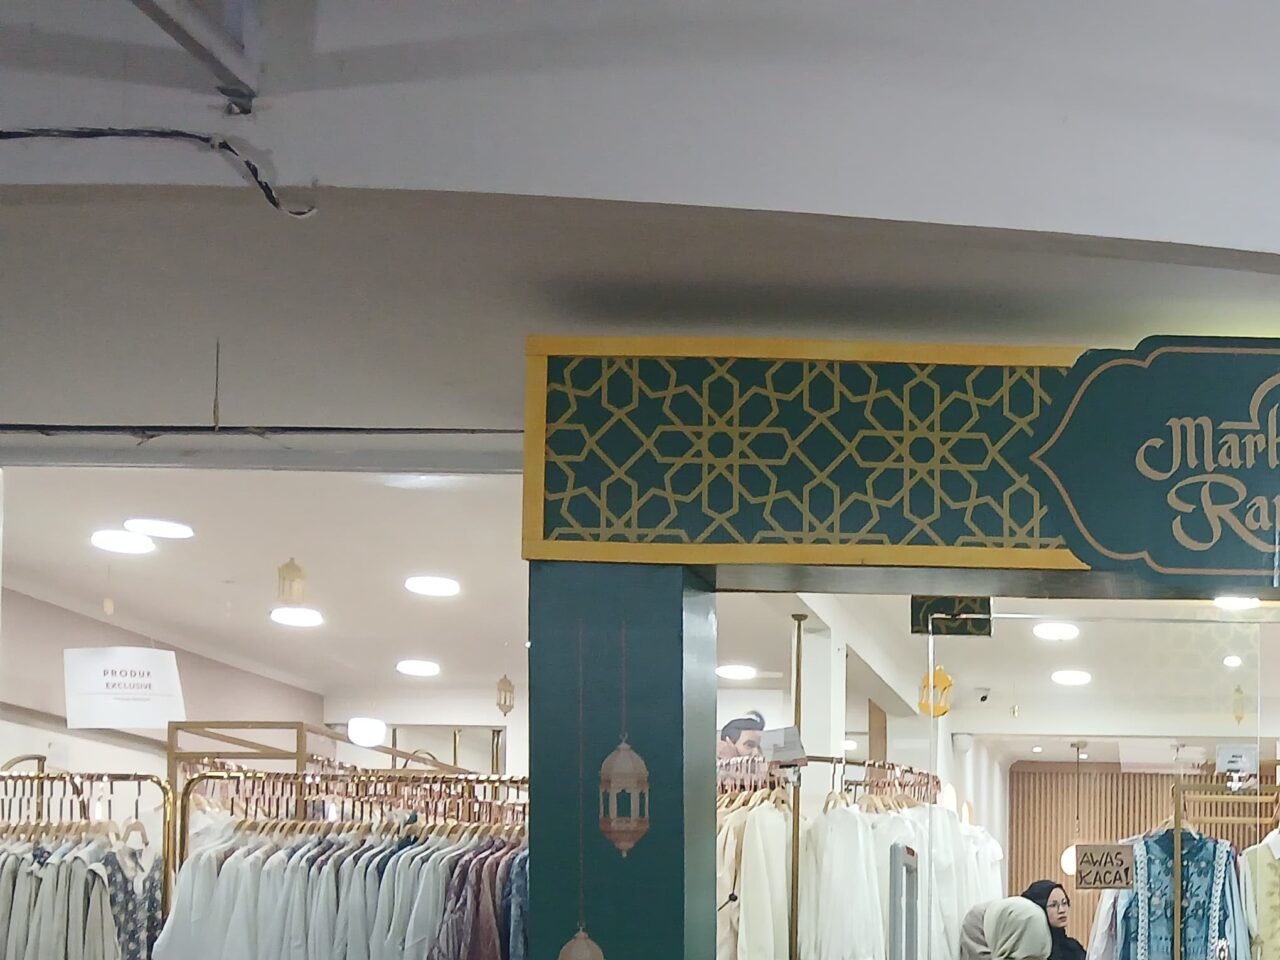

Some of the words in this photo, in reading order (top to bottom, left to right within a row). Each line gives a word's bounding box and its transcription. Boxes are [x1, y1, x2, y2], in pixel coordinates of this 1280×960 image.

[105, 682, 152, 690] EXCLUSIVE
[1079, 851, 1124, 867] AWAS
[1079, 866, 1130, 885] KACA!
